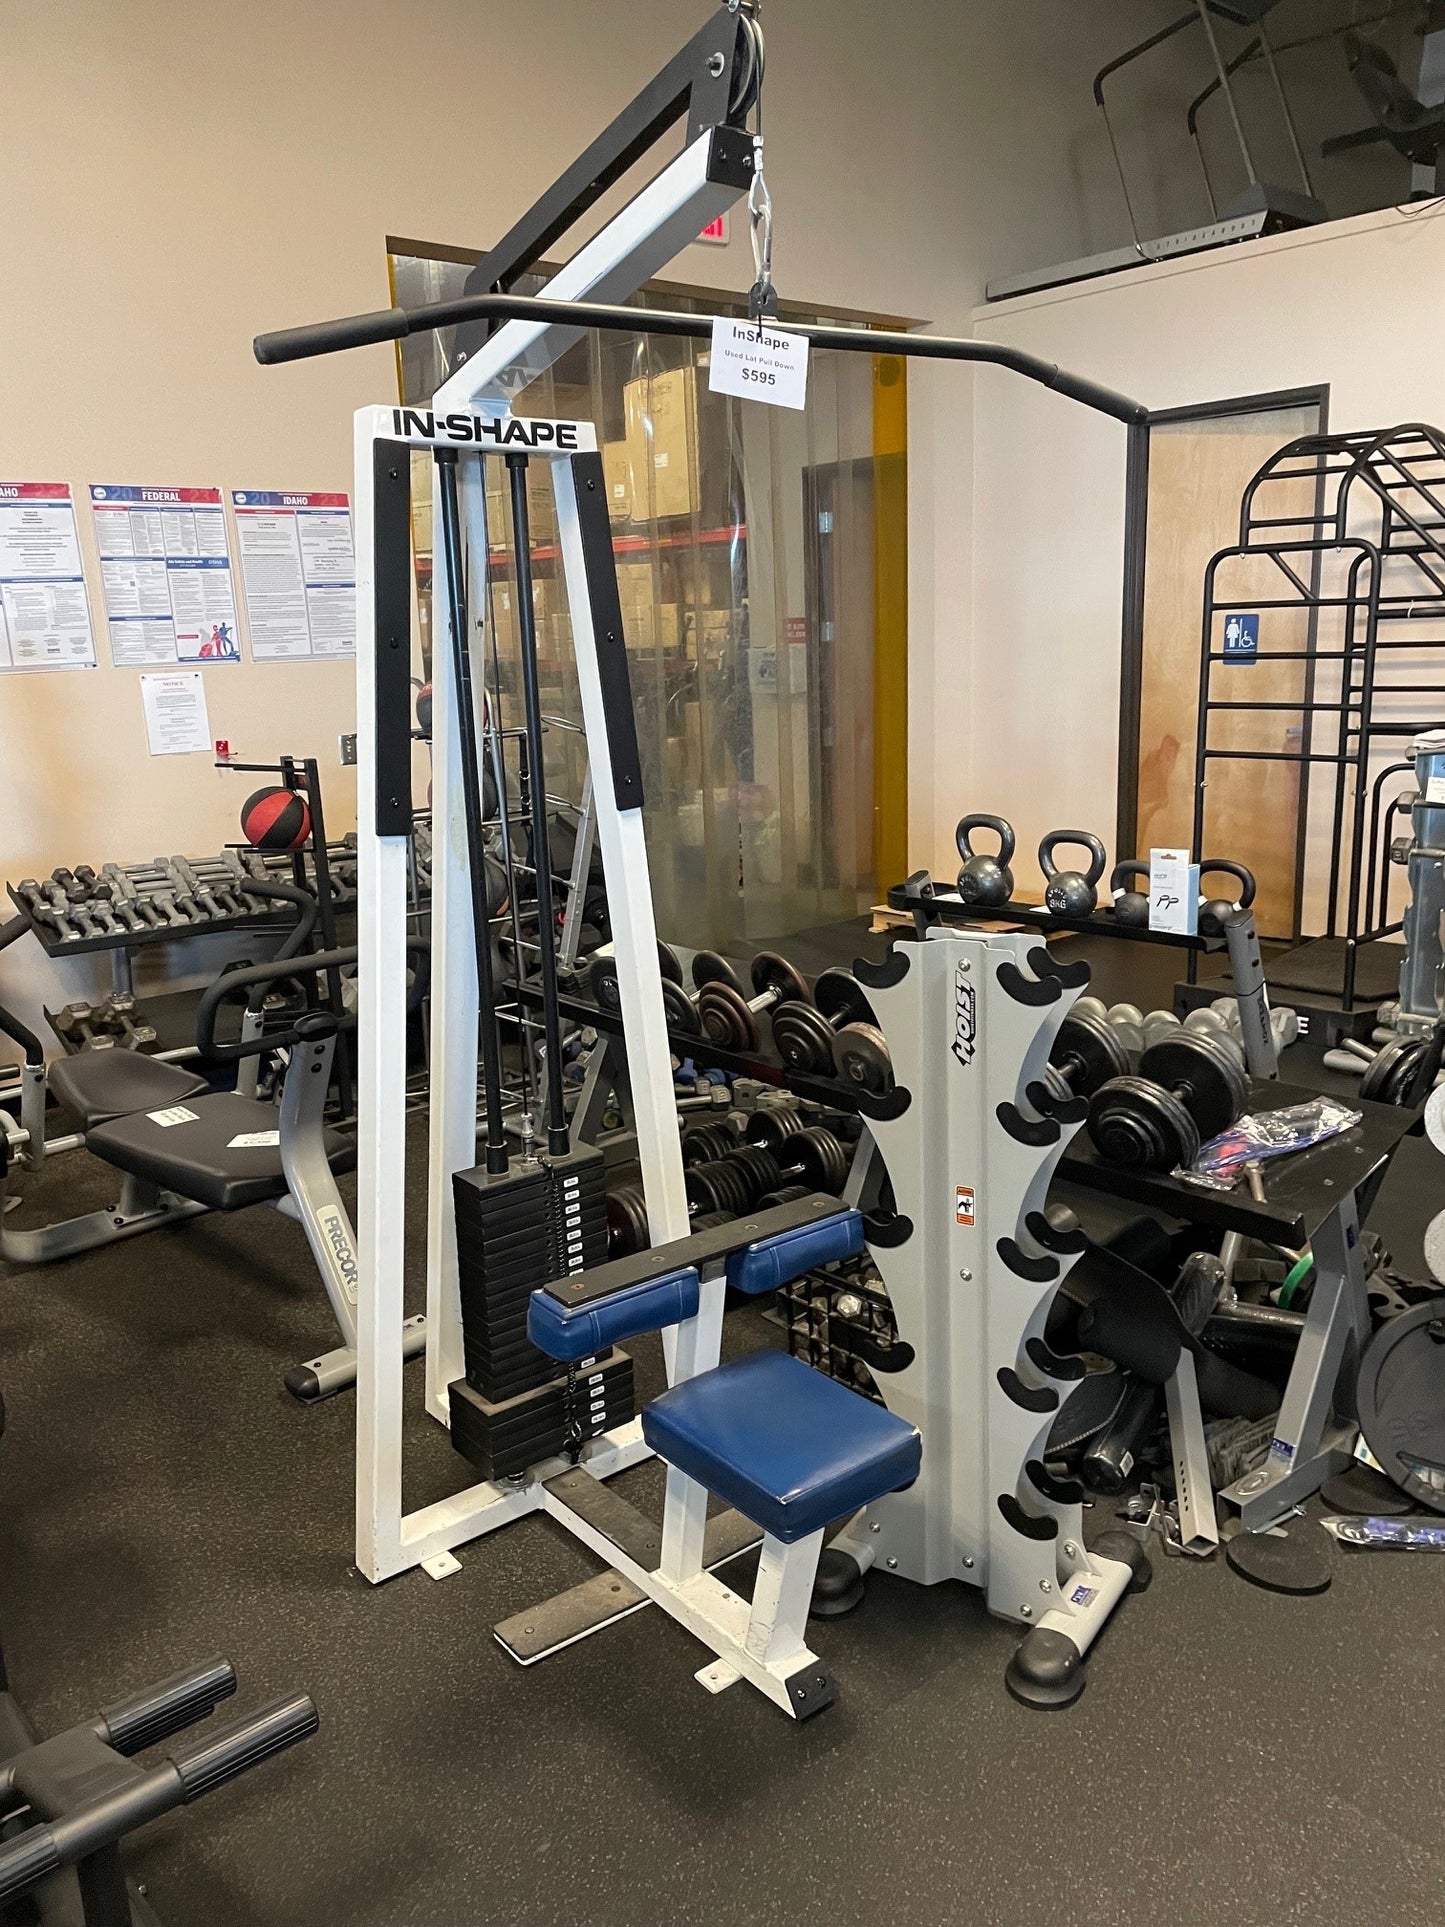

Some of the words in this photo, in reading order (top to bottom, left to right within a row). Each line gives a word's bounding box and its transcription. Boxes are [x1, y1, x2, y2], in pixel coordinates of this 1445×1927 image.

[732, 326, 790, 350] InShape
[724, 349, 744, 359] Used
[745, 354, 757, 363] Lat
[774, 360, 795, 371] Down
[741, 368, 776, 386] $595
[392, 409, 578, 450] IN-SHAPE
[142, 491, 181, 501] FEDERAL
[283, 496, 309, 506] IDAHO
[955, 969, 972, 1066] HOIST
[324, 1216, 358, 1285] PRECOR
